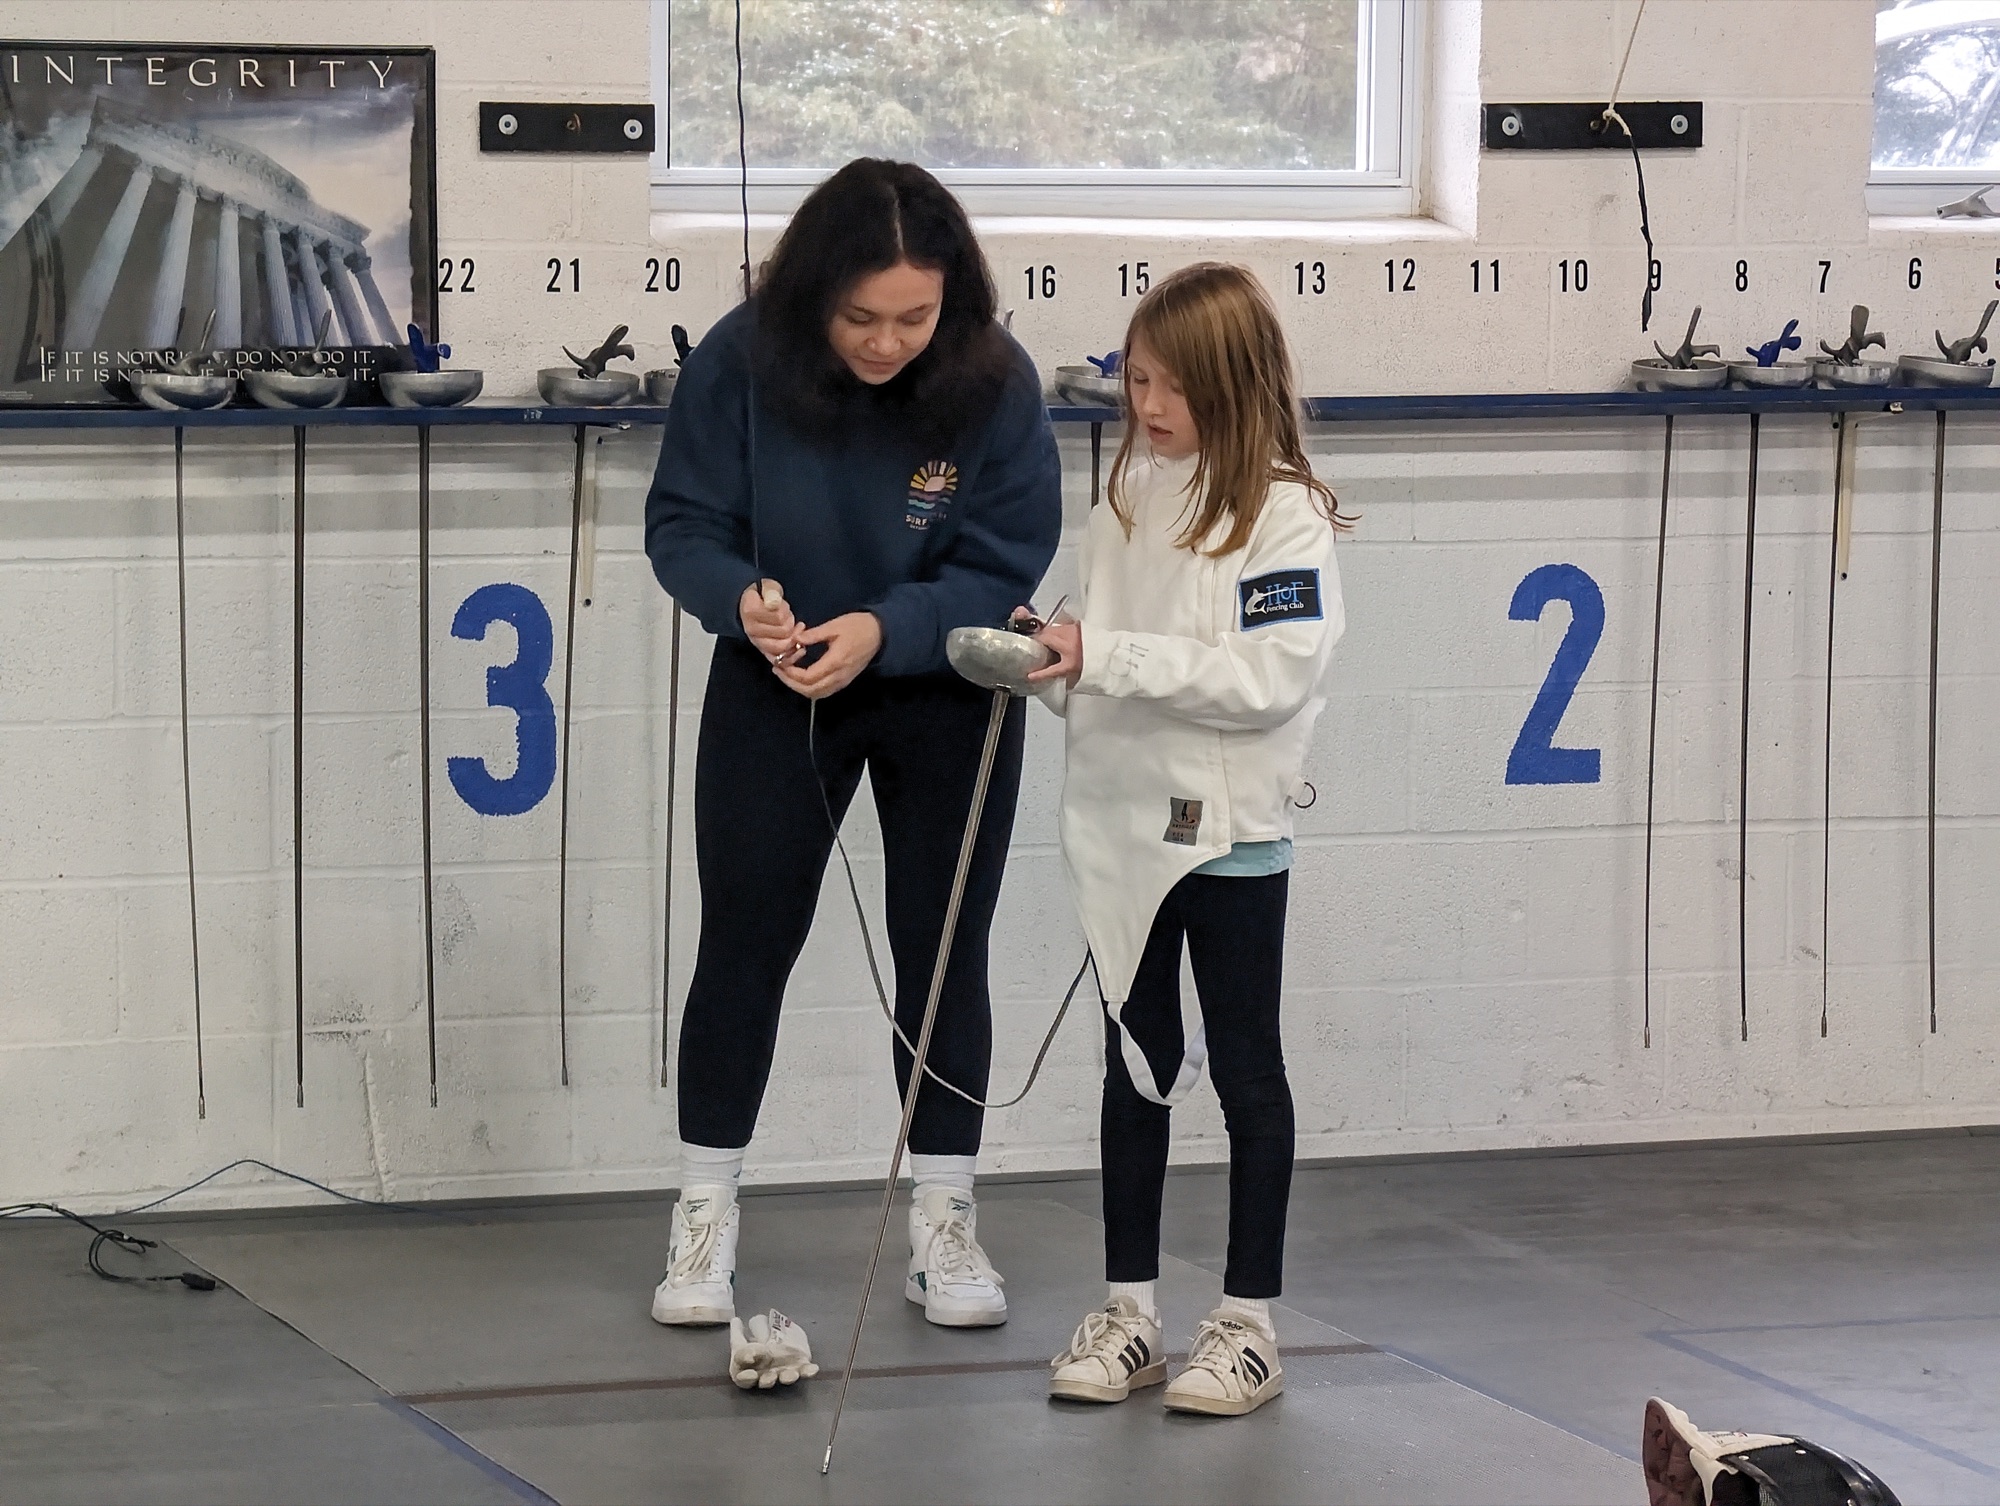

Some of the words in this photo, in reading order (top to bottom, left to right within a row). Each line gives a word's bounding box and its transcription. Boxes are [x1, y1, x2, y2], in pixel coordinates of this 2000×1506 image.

[11, 54, 394, 89] INTEGRITY
[438, 257, 476, 293] 22
[546, 257, 581, 293] 21
[644, 257, 681, 293] 20
[1024, 264, 1056, 300] 16
[1118, 261, 1150, 297] 15
[1294, 260, 1327, 296] 13
[1384, 257, 1416, 293] 12
[1469, 259, 1501, 293] 11
[1558, 259, 1589, 293] 10
[1648, 259, 1662, 292] 9
[1734, 259, 1749, 292] 8
[1818, 260, 1833, 294] 7
[1908, 257, 1922, 290] 6
[65, 351, 84, 365] IT
[93, 351, 109, 365] IS
[117, 351, 156, 365] NOT
[236, 350, 263, 366] DO
[353, 350, 376, 365] IT.
[66, 369, 85, 383] IT
[94, 369, 110, 383] IS
[353, 368, 376, 382] IT.
[1289, 601, 1304, 609] Club
[1505, 563, 1606, 785] 2
[447, 582, 557, 816] 3
